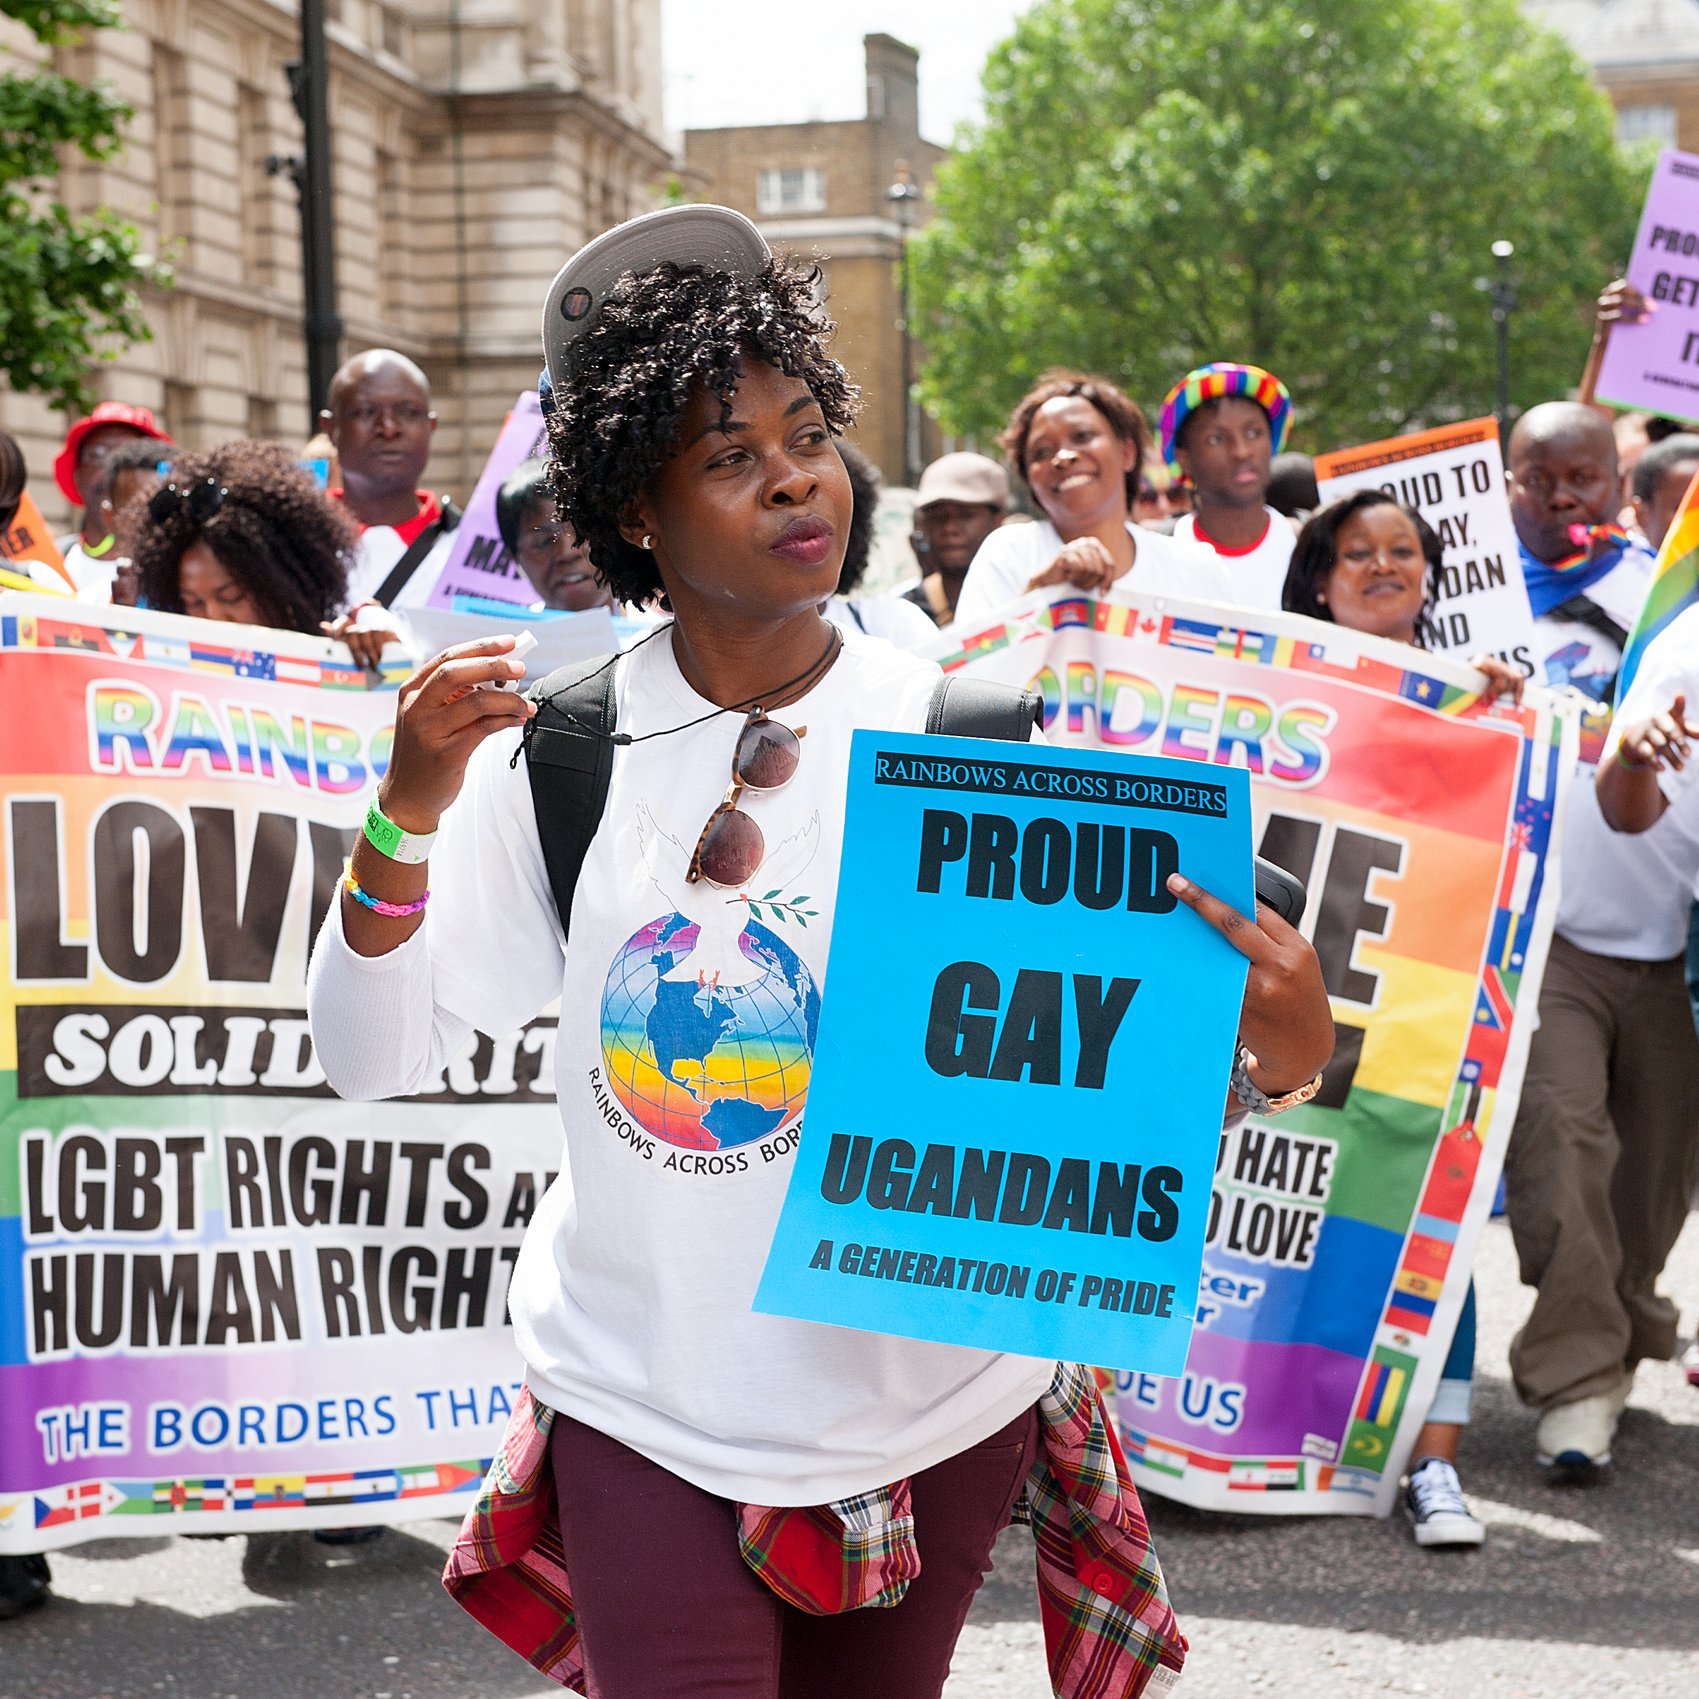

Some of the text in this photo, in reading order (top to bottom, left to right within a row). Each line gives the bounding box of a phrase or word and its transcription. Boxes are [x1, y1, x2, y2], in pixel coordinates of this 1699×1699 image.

[1451, 459, 1490, 498] TO
[464, 534, 521, 580] MA
[1437, 553, 1506, 600] DAN
[876, 757, 1227, 812] RAINBOWS ACROSS BORDERS
[11, 800, 360, 983] LOV
[916, 808, 1180, 914] PROUD
[924, 961, 1142, 1090] GAY
[588, 1067, 656, 1160] RAINBOWS
[663, 1151, 749, 1175] ACROSS
[27, 1135, 560, 1235] LGBT RIGHTS A
[820, 1133, 1183, 1243] UGANDANS
[1234, 1128, 1332, 1198] HATE
[1227, 1197, 1319, 1263] LOVE
[31, 1249, 302, 1354] HUMAN
[808, 1239, 1176, 1319] A GENERATION OF PRIDE
[42, 1382, 524, 1456] THE BORDERS THA
[1182, 1378, 1242, 1428] US
